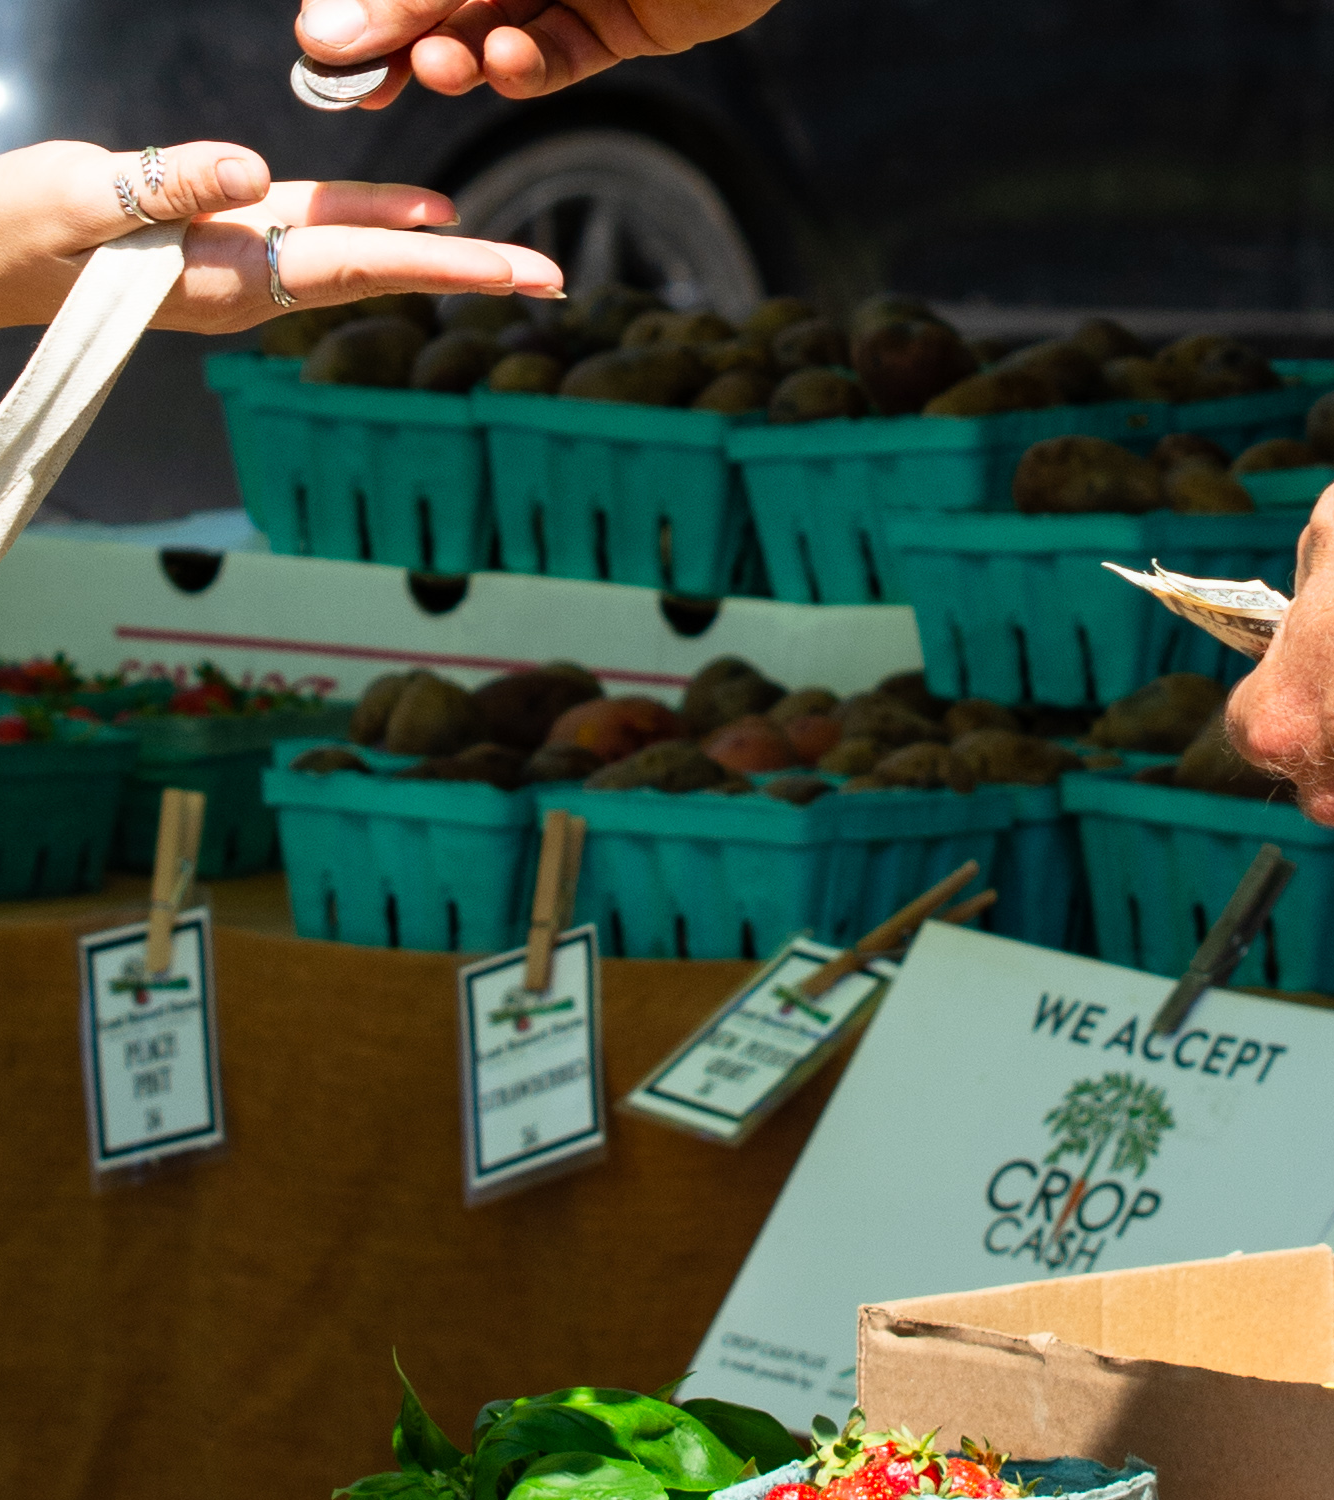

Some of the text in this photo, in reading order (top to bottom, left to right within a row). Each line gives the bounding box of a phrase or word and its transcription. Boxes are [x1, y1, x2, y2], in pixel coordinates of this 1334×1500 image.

[1032, 992, 1289, 1085] WE ACCEPT
[985, 1157, 1163, 1239] CROP
